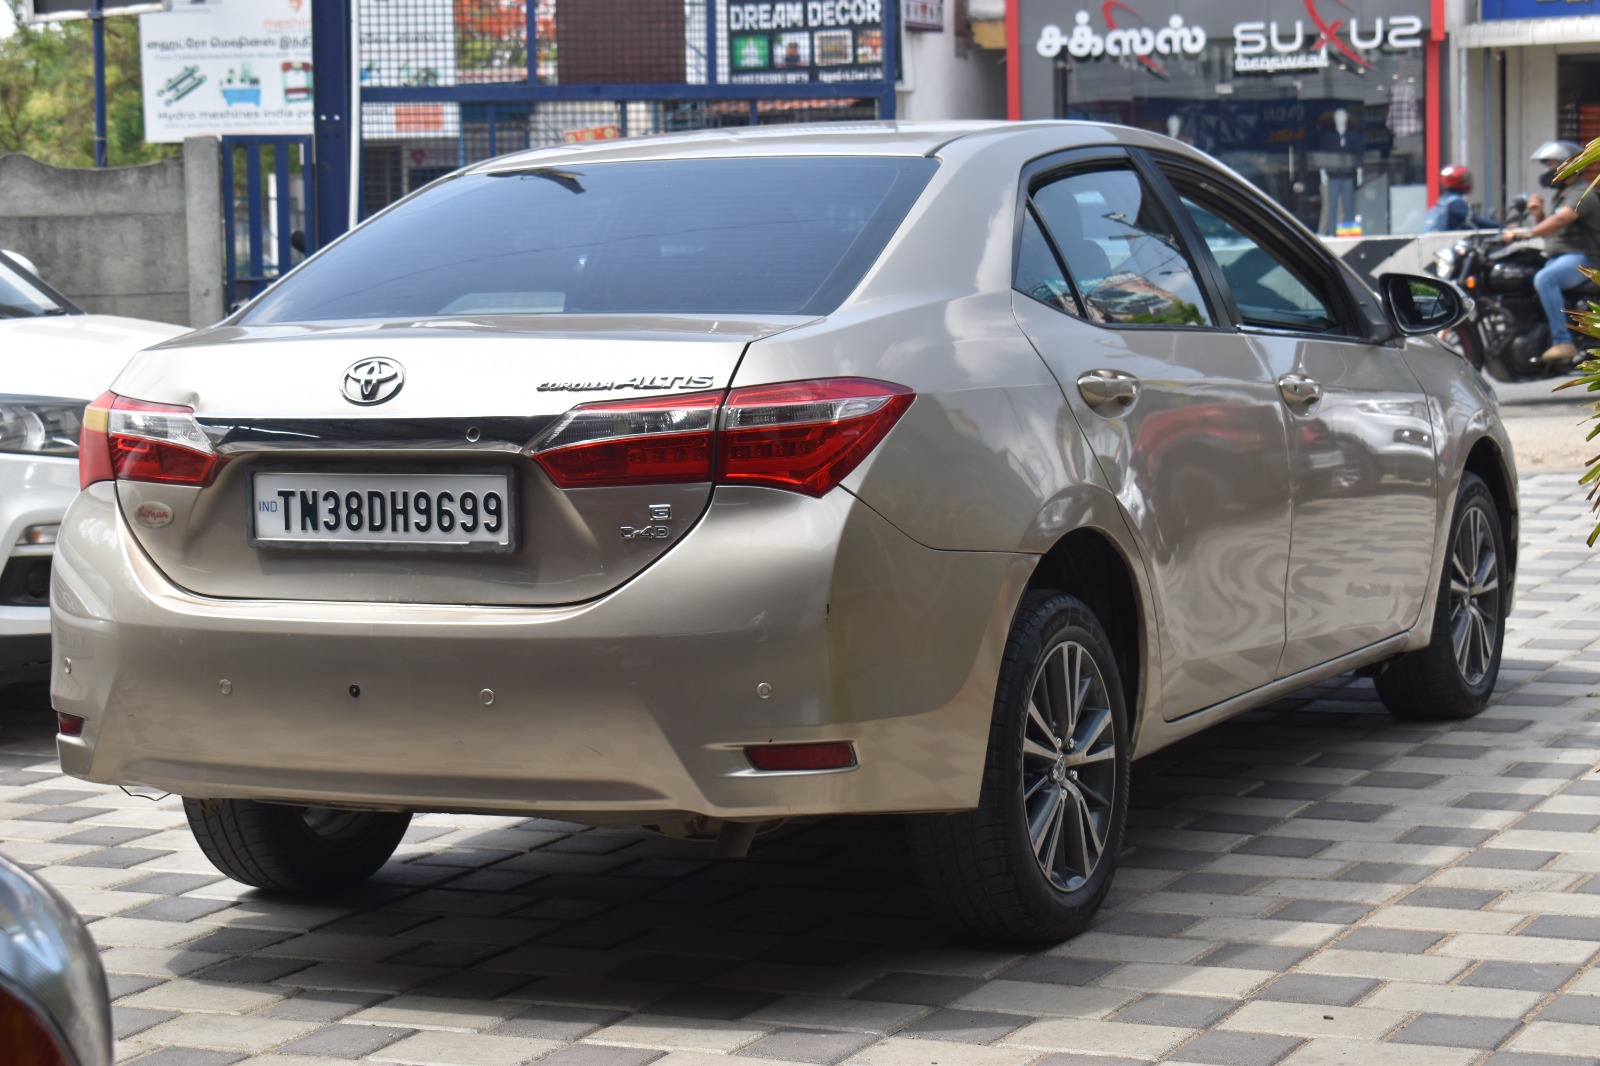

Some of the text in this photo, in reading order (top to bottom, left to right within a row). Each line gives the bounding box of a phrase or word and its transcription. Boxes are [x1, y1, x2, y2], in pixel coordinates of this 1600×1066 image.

[729, 0, 882, 31] DREAM DECOR
[1036, 10, 1207, 58] சக்ஸஸ்
[158, 111, 196, 122] Hydro
[537, 375, 714, 392] COROLLA ALTIS
[258, 489, 502, 533] IND TN38DH9699
[620, 525, 670, 539] D-4D
